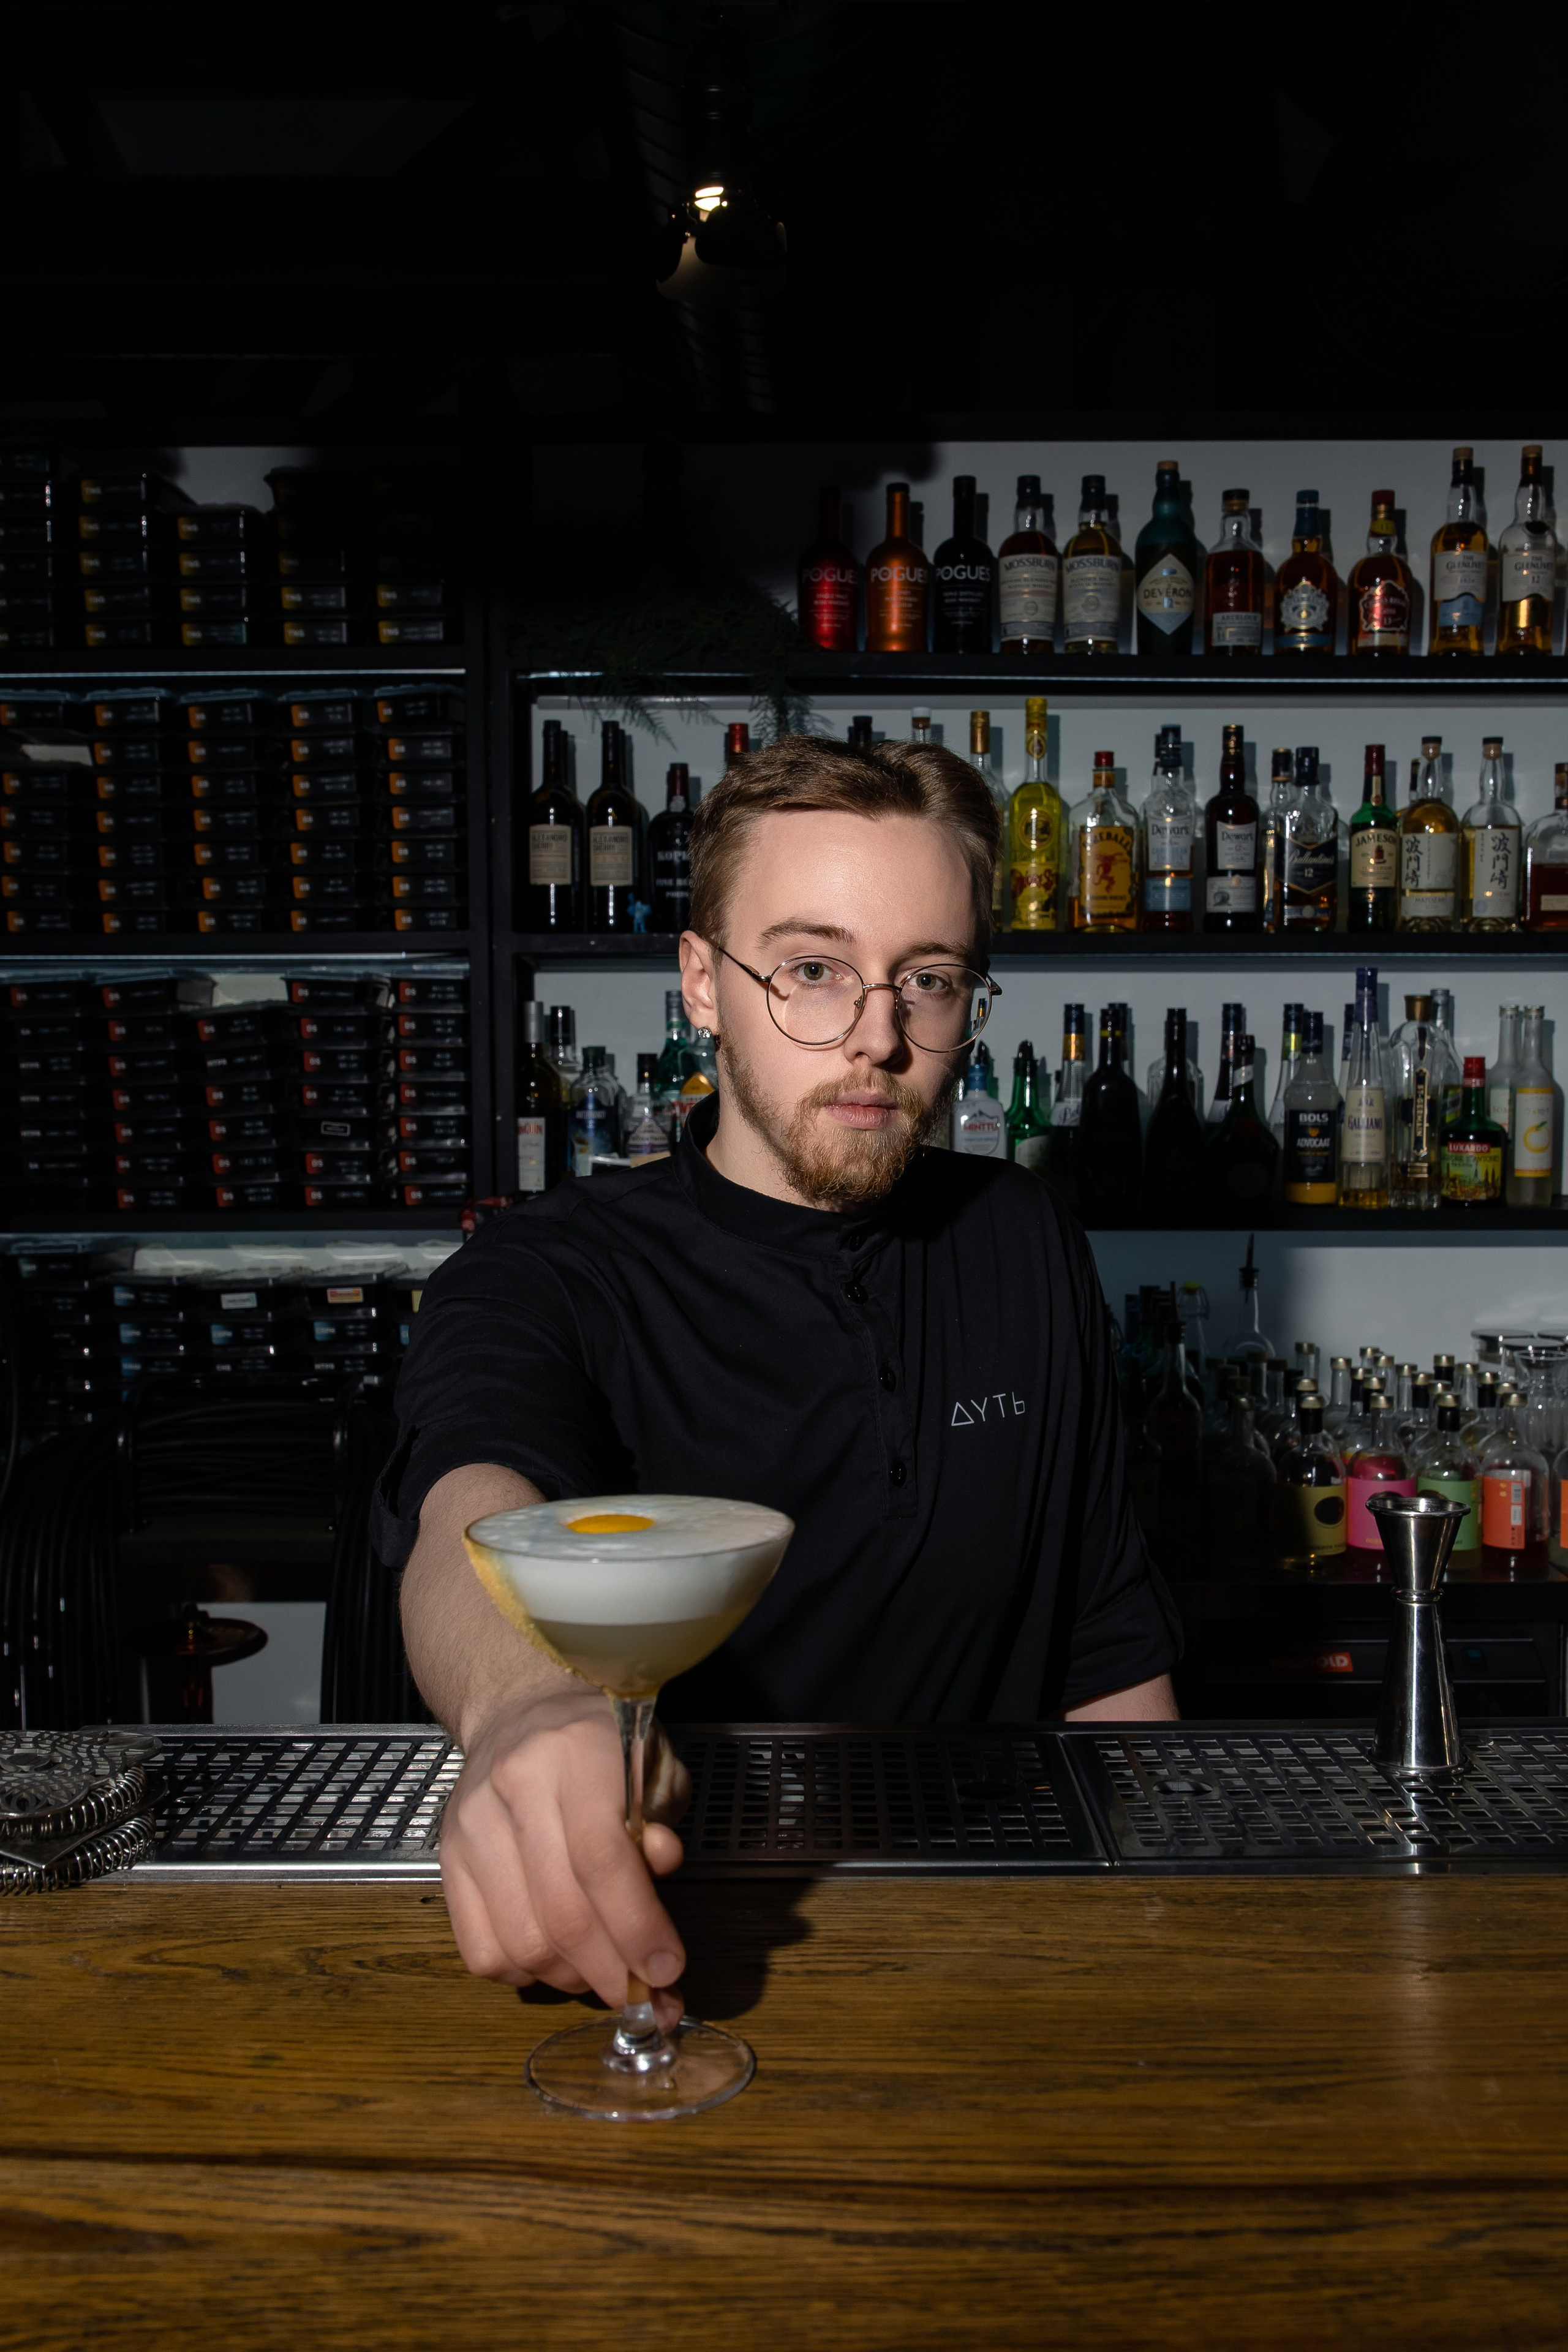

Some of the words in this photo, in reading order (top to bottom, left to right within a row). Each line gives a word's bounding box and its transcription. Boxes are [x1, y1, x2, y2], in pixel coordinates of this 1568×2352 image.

[801, 566, 858, 584] POGUE
[1143, 587, 1192, 599] DEVERON
[1082, 831, 1132, 852] REBALL
[1355, 832, 1397, 848] JAMESON
[657, 850, 690, 862] KOPK
[1304, 867, 1314, 878] 12
[297, 988, 309, 997] DS
[404, 987, 417, 996] DS
[108, 992, 121, 1001] DS
[203, 1025, 216, 1034] DS
[306, 1024, 318, 1033] DS
[404, 1021, 417, 1030] DS
[114, 1026, 126, 1035] DS
[309, 1057, 321, 1066] DS
[405, 1055, 417, 1065] DS
[114, 1061, 126, 1070] DS
[211, 1091, 224, 1100] DS
[306, 1091, 318, 1099] DS
[404, 1089, 417, 1098] DS
[118, 1095, 130, 1104] DS
[1298, 1112, 1329, 1123] BOLS
[214, 1125, 227, 1134] DS
[405, 1122, 418, 1131] DS
[121, 1128, 133, 1137] DS
[1297, 1137, 1330, 1148] ADVOCAAT
[1449, 1144, 1489, 1153] LUXARDO
[118, 1160, 130, 1169] DS
[218, 1159, 231, 1167] DS
[311, 1159, 324, 1167] DS
[405, 1156, 417, 1166] DS
[123, 1194, 135, 1203] DS
[222, 1192, 234, 1200] DS
[311, 1191, 323, 1200] DS
[410, 1191, 423, 1199] DS
